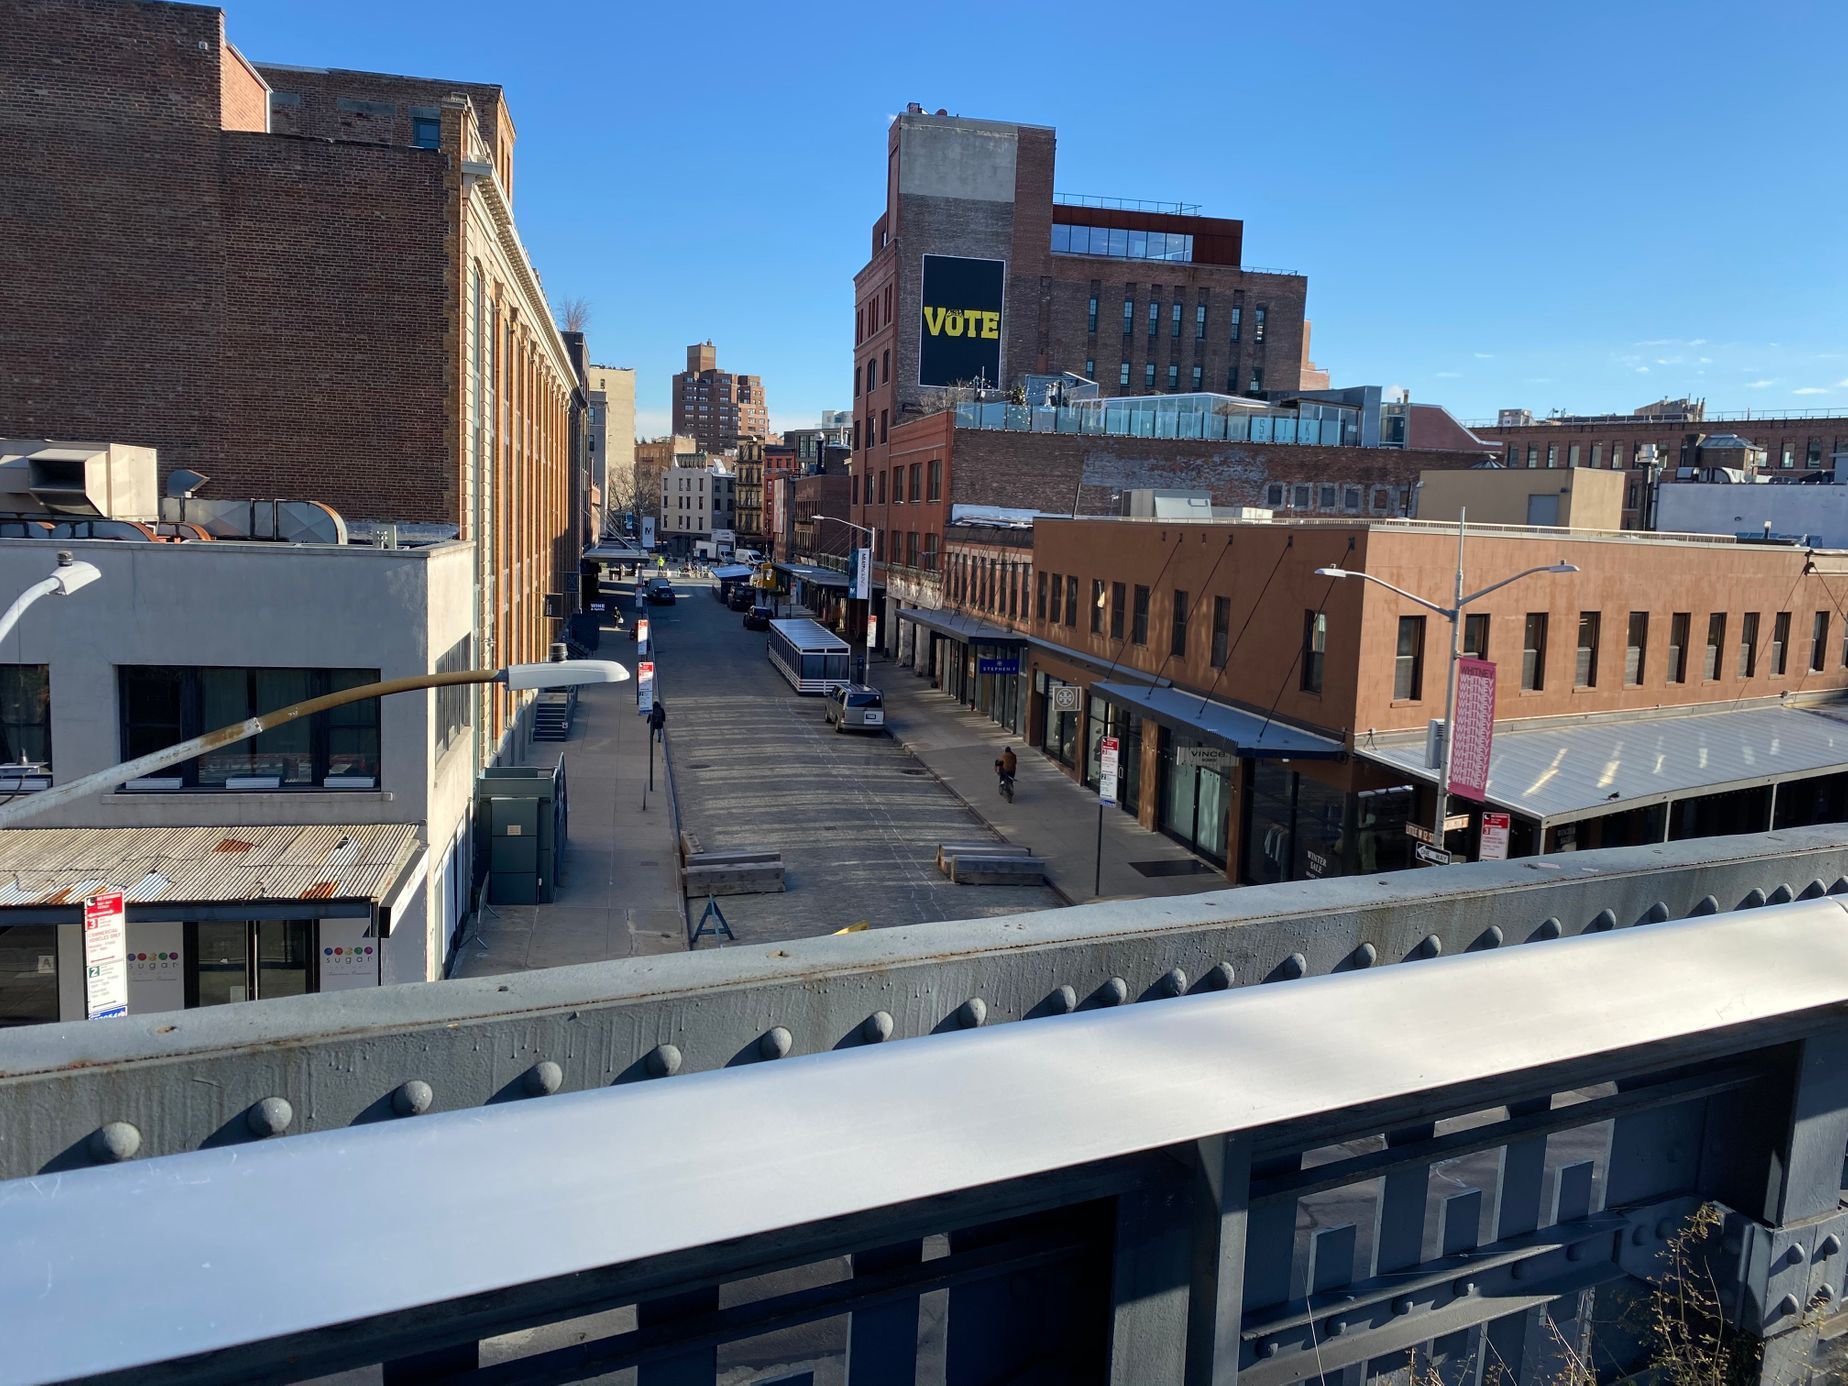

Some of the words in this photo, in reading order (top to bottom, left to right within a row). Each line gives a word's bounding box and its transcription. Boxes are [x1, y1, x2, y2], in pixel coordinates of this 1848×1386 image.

[923, 306, 1000, 339] VOTE
[1461, 666, 1494, 679] WHITNEY
[1307, 850, 1327, 867] WINTER
[1420, 848, 1430, 857] ONE
[1436, 854, 1448, 862] WAY
[88, 920, 96, 928] 3
[326, 956, 372, 964] sugar
[128, 962, 178, 970] sugar
[90, 967, 98, 977] 2
